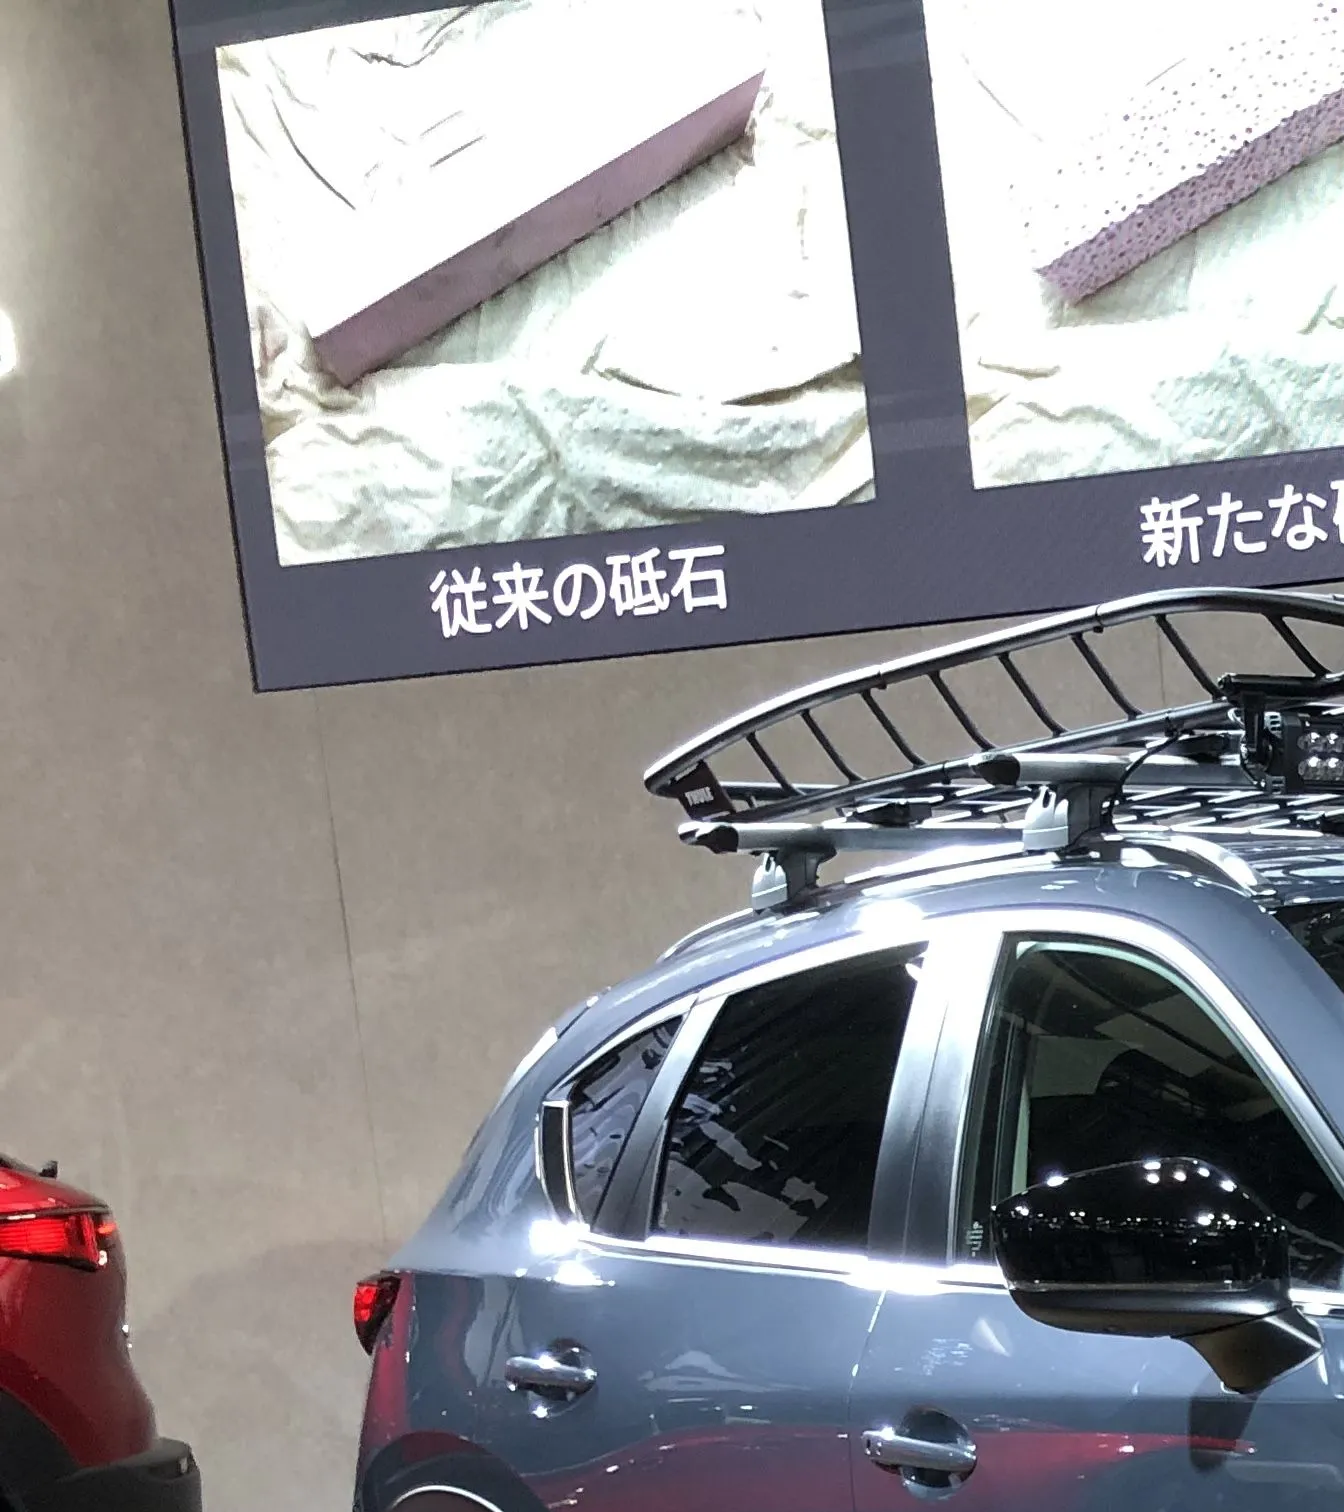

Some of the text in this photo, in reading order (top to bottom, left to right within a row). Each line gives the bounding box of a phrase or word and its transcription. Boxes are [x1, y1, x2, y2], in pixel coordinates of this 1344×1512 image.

[429, 545, 728, 638] 従来の砥石
